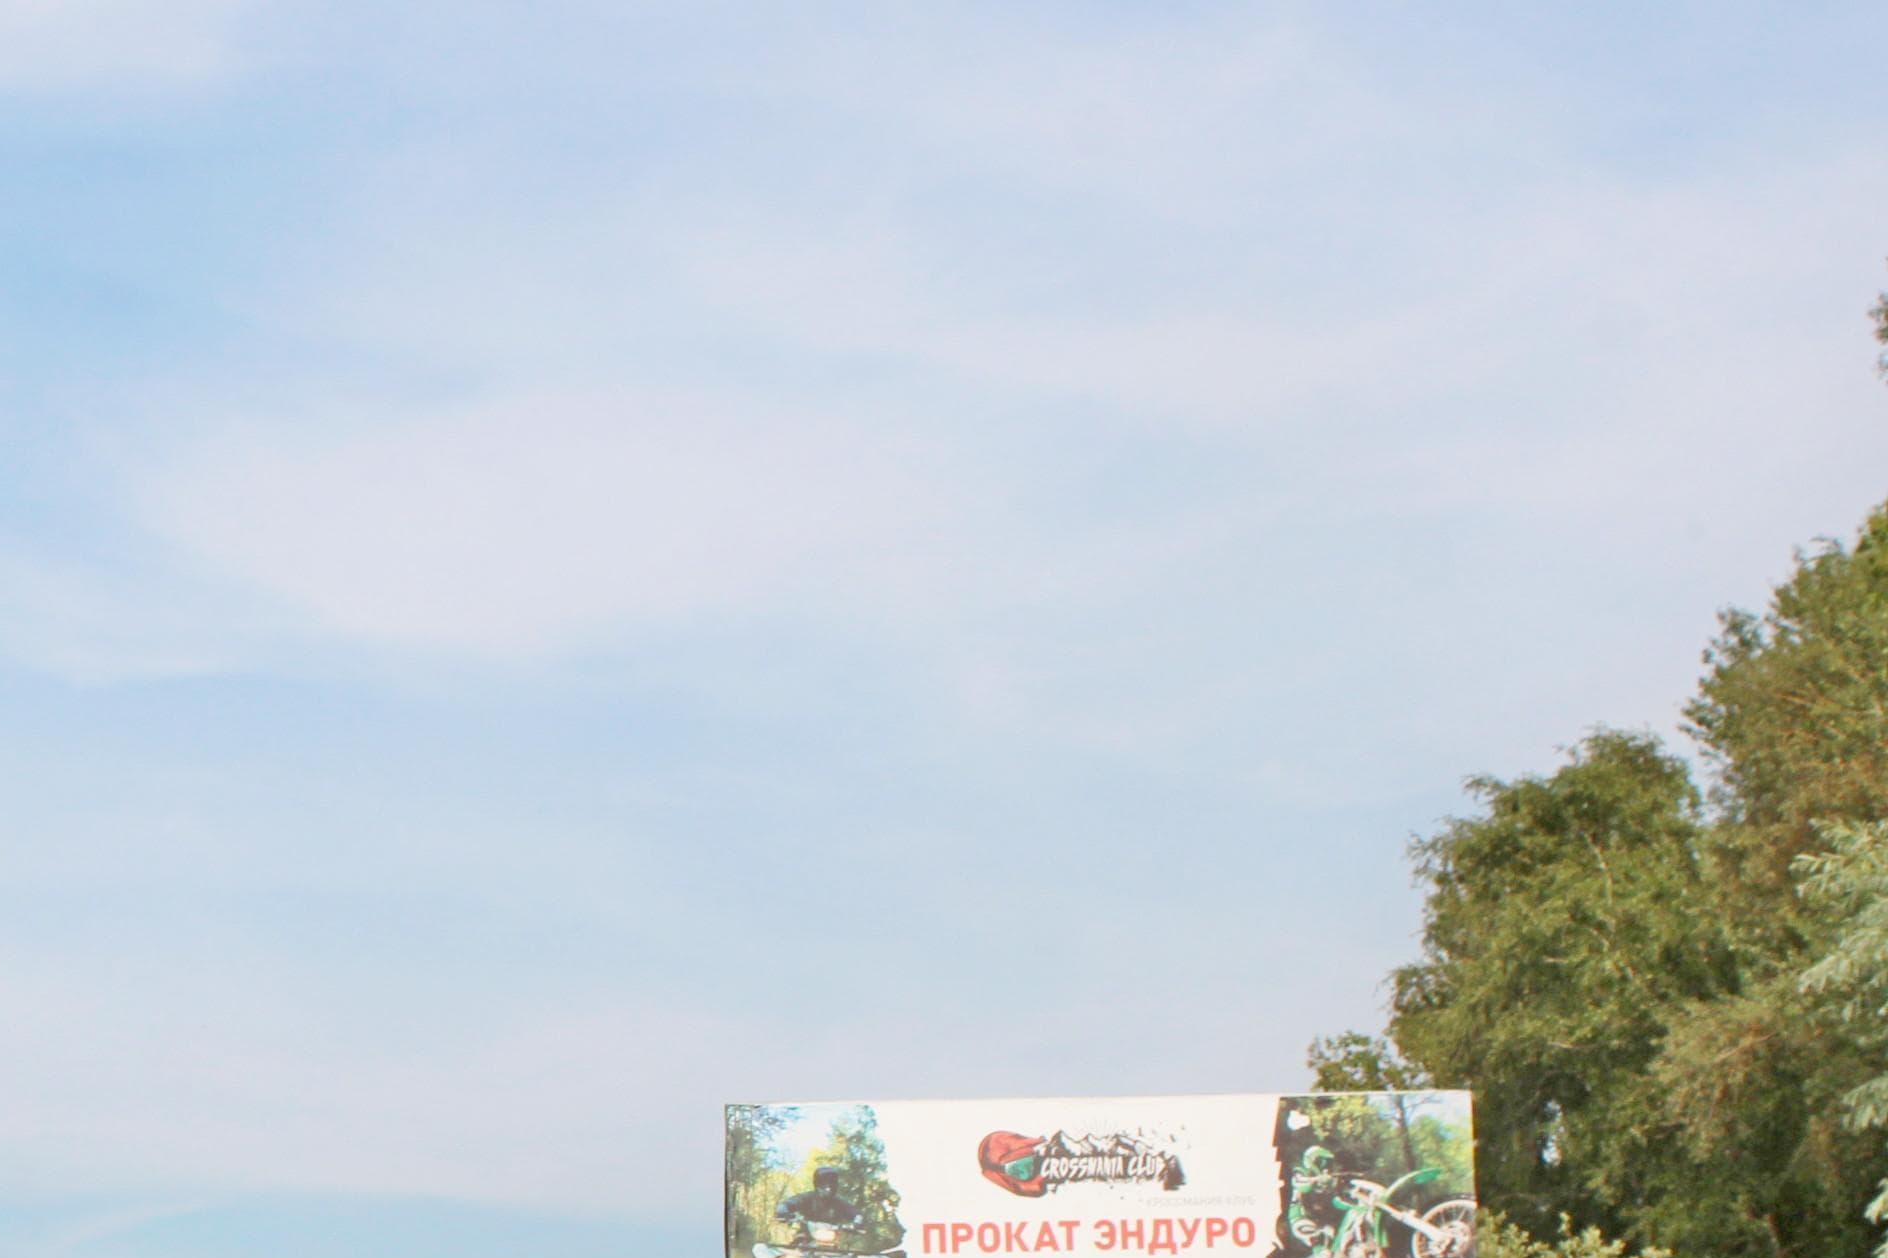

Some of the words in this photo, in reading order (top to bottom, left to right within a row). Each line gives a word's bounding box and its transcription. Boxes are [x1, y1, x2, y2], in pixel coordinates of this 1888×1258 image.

[1040, 1155, 1124, 1179] CROSSMANIA
[922, 1220, 1081, 1254] ПРОКАТ
[1093, 1217, 1256, 1255] ЭНДУРО
